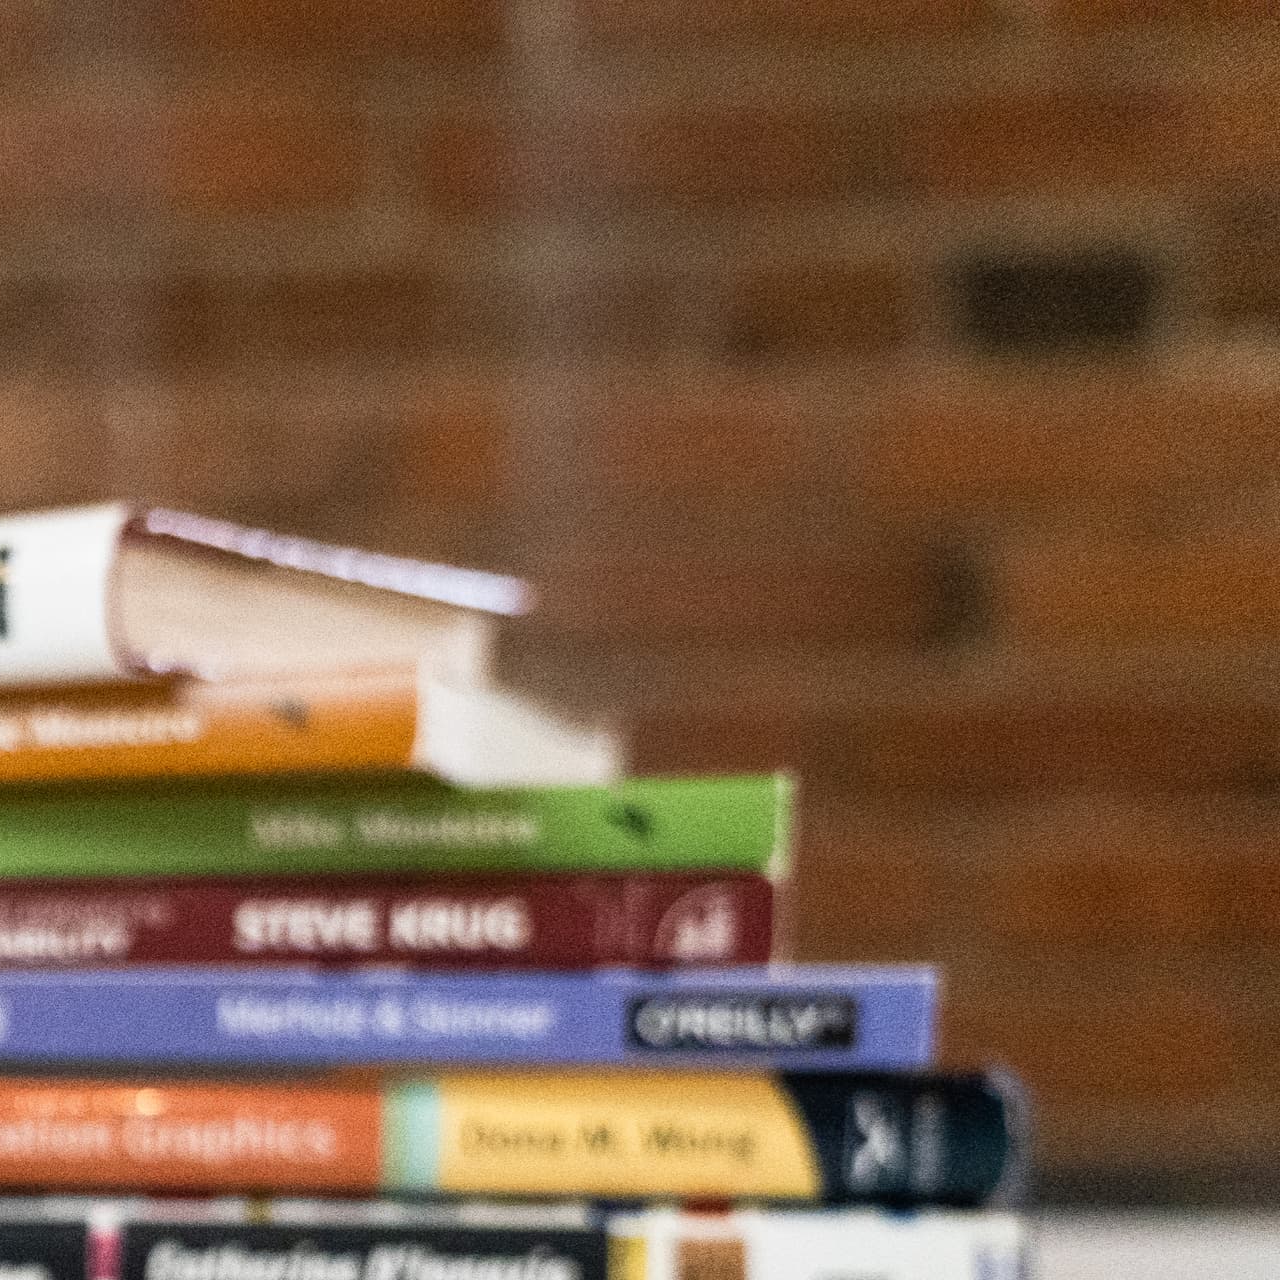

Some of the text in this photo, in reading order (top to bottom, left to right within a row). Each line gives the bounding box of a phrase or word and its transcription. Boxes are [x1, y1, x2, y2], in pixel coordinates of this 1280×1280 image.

[232, 898, 378, 952] STEVE
[386, 898, 532, 951] KRUG
[122, 1108, 337, 1169] Graphics
[460, 1120, 561, 1158] Dona
[638, 1120, 758, 1167] Wong
